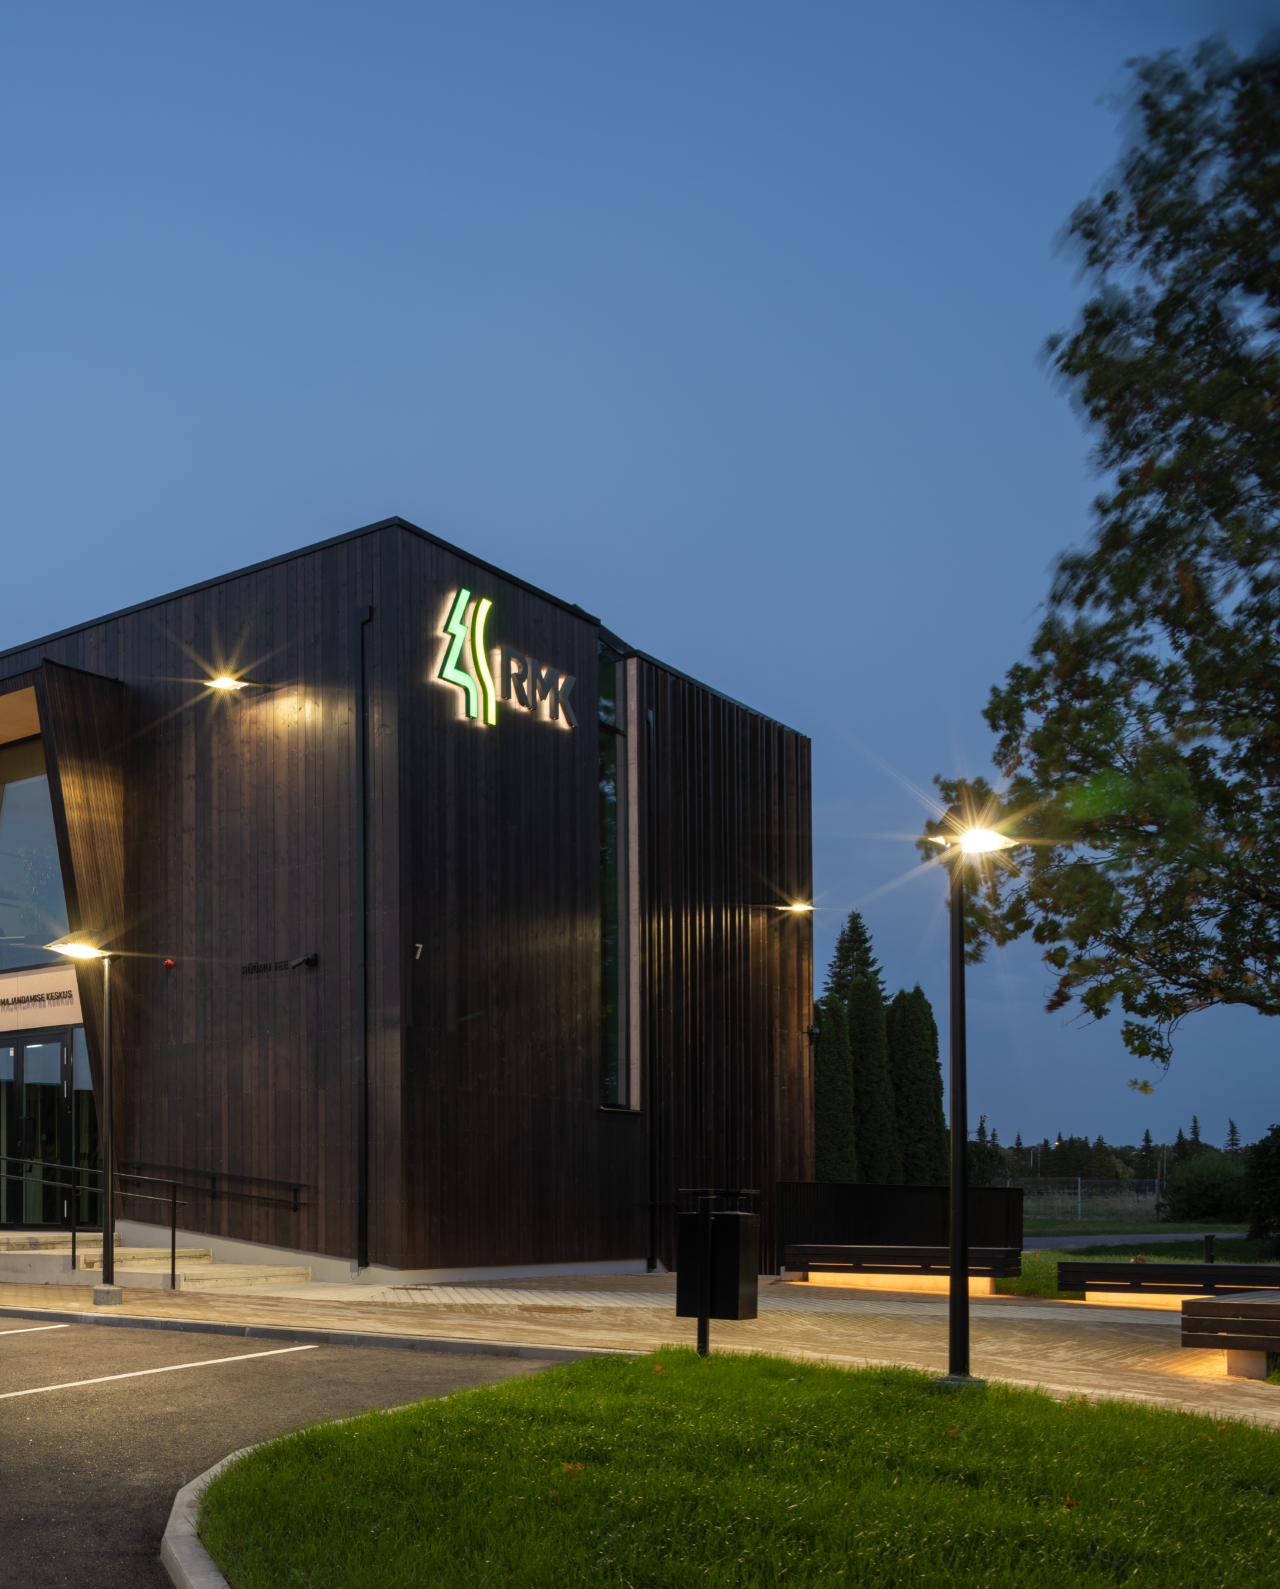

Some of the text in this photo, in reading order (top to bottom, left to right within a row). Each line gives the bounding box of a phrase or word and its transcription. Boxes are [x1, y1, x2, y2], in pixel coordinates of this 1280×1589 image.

[501, 645, 578, 728] RMK
[415, 943, 423, 960] 7
[275, 960, 289, 971] TEE
[0, 993, 46, 1007] MAJANDAMISE
[46, 990, 73, 1001] KESKUS
